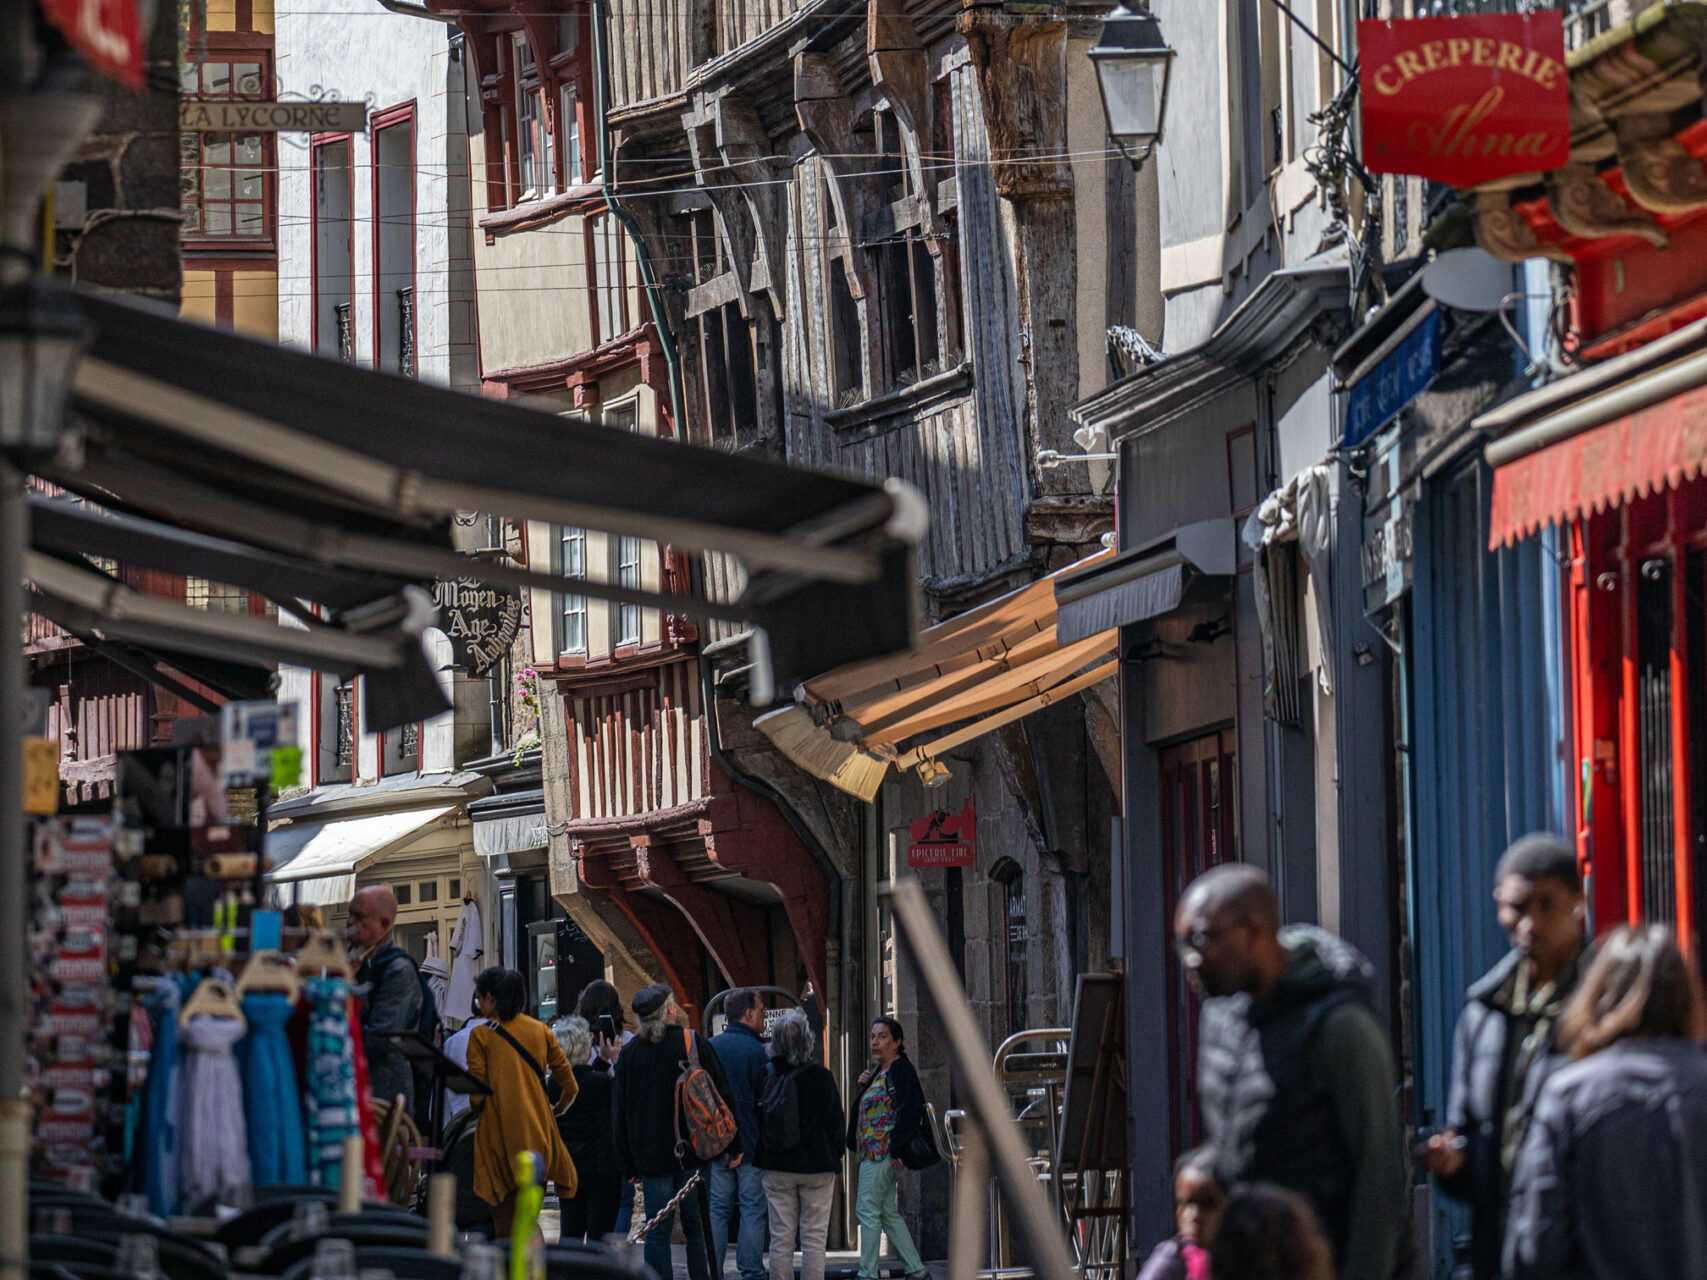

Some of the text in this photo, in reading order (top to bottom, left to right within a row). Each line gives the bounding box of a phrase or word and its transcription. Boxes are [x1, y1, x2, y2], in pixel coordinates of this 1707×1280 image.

[1373, 37, 1565, 96] CREPERIE
[222, 106, 341, 127] LYCORNE
[432, 580, 505, 613] Moyen
[447, 609, 497, 644] Age
